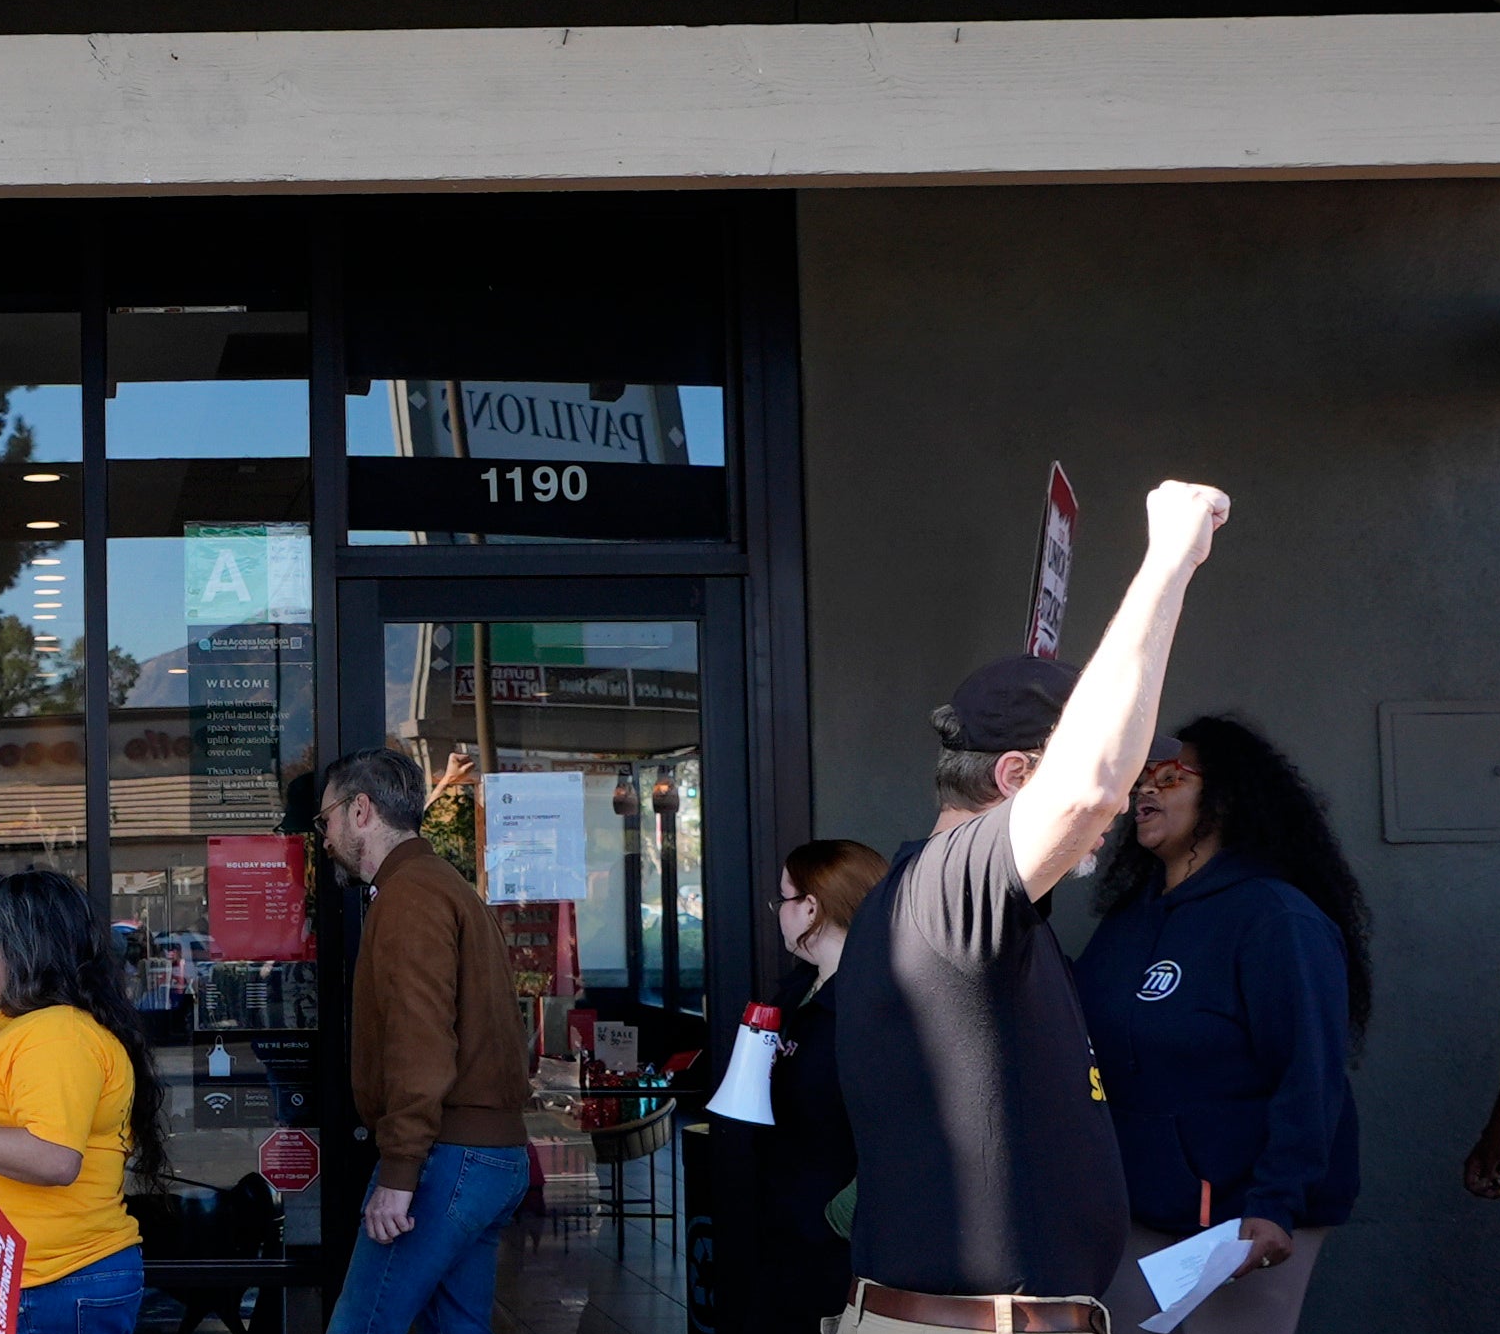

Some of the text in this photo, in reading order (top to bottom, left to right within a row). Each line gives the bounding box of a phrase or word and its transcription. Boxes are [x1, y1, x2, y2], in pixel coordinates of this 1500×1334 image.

[481, 465, 588, 502] 1190
[200, 549, 252, 603] A
[206, 679, 270, 689] WELCOME
[237, 711, 252, 719] and
[207, 724, 230, 733] space
[231, 724, 256, 732] where
[207, 767, 232, 775] Thank
[1142, 972, 1174, 991] 770
[4, 1234, 16, 1270] NOW
